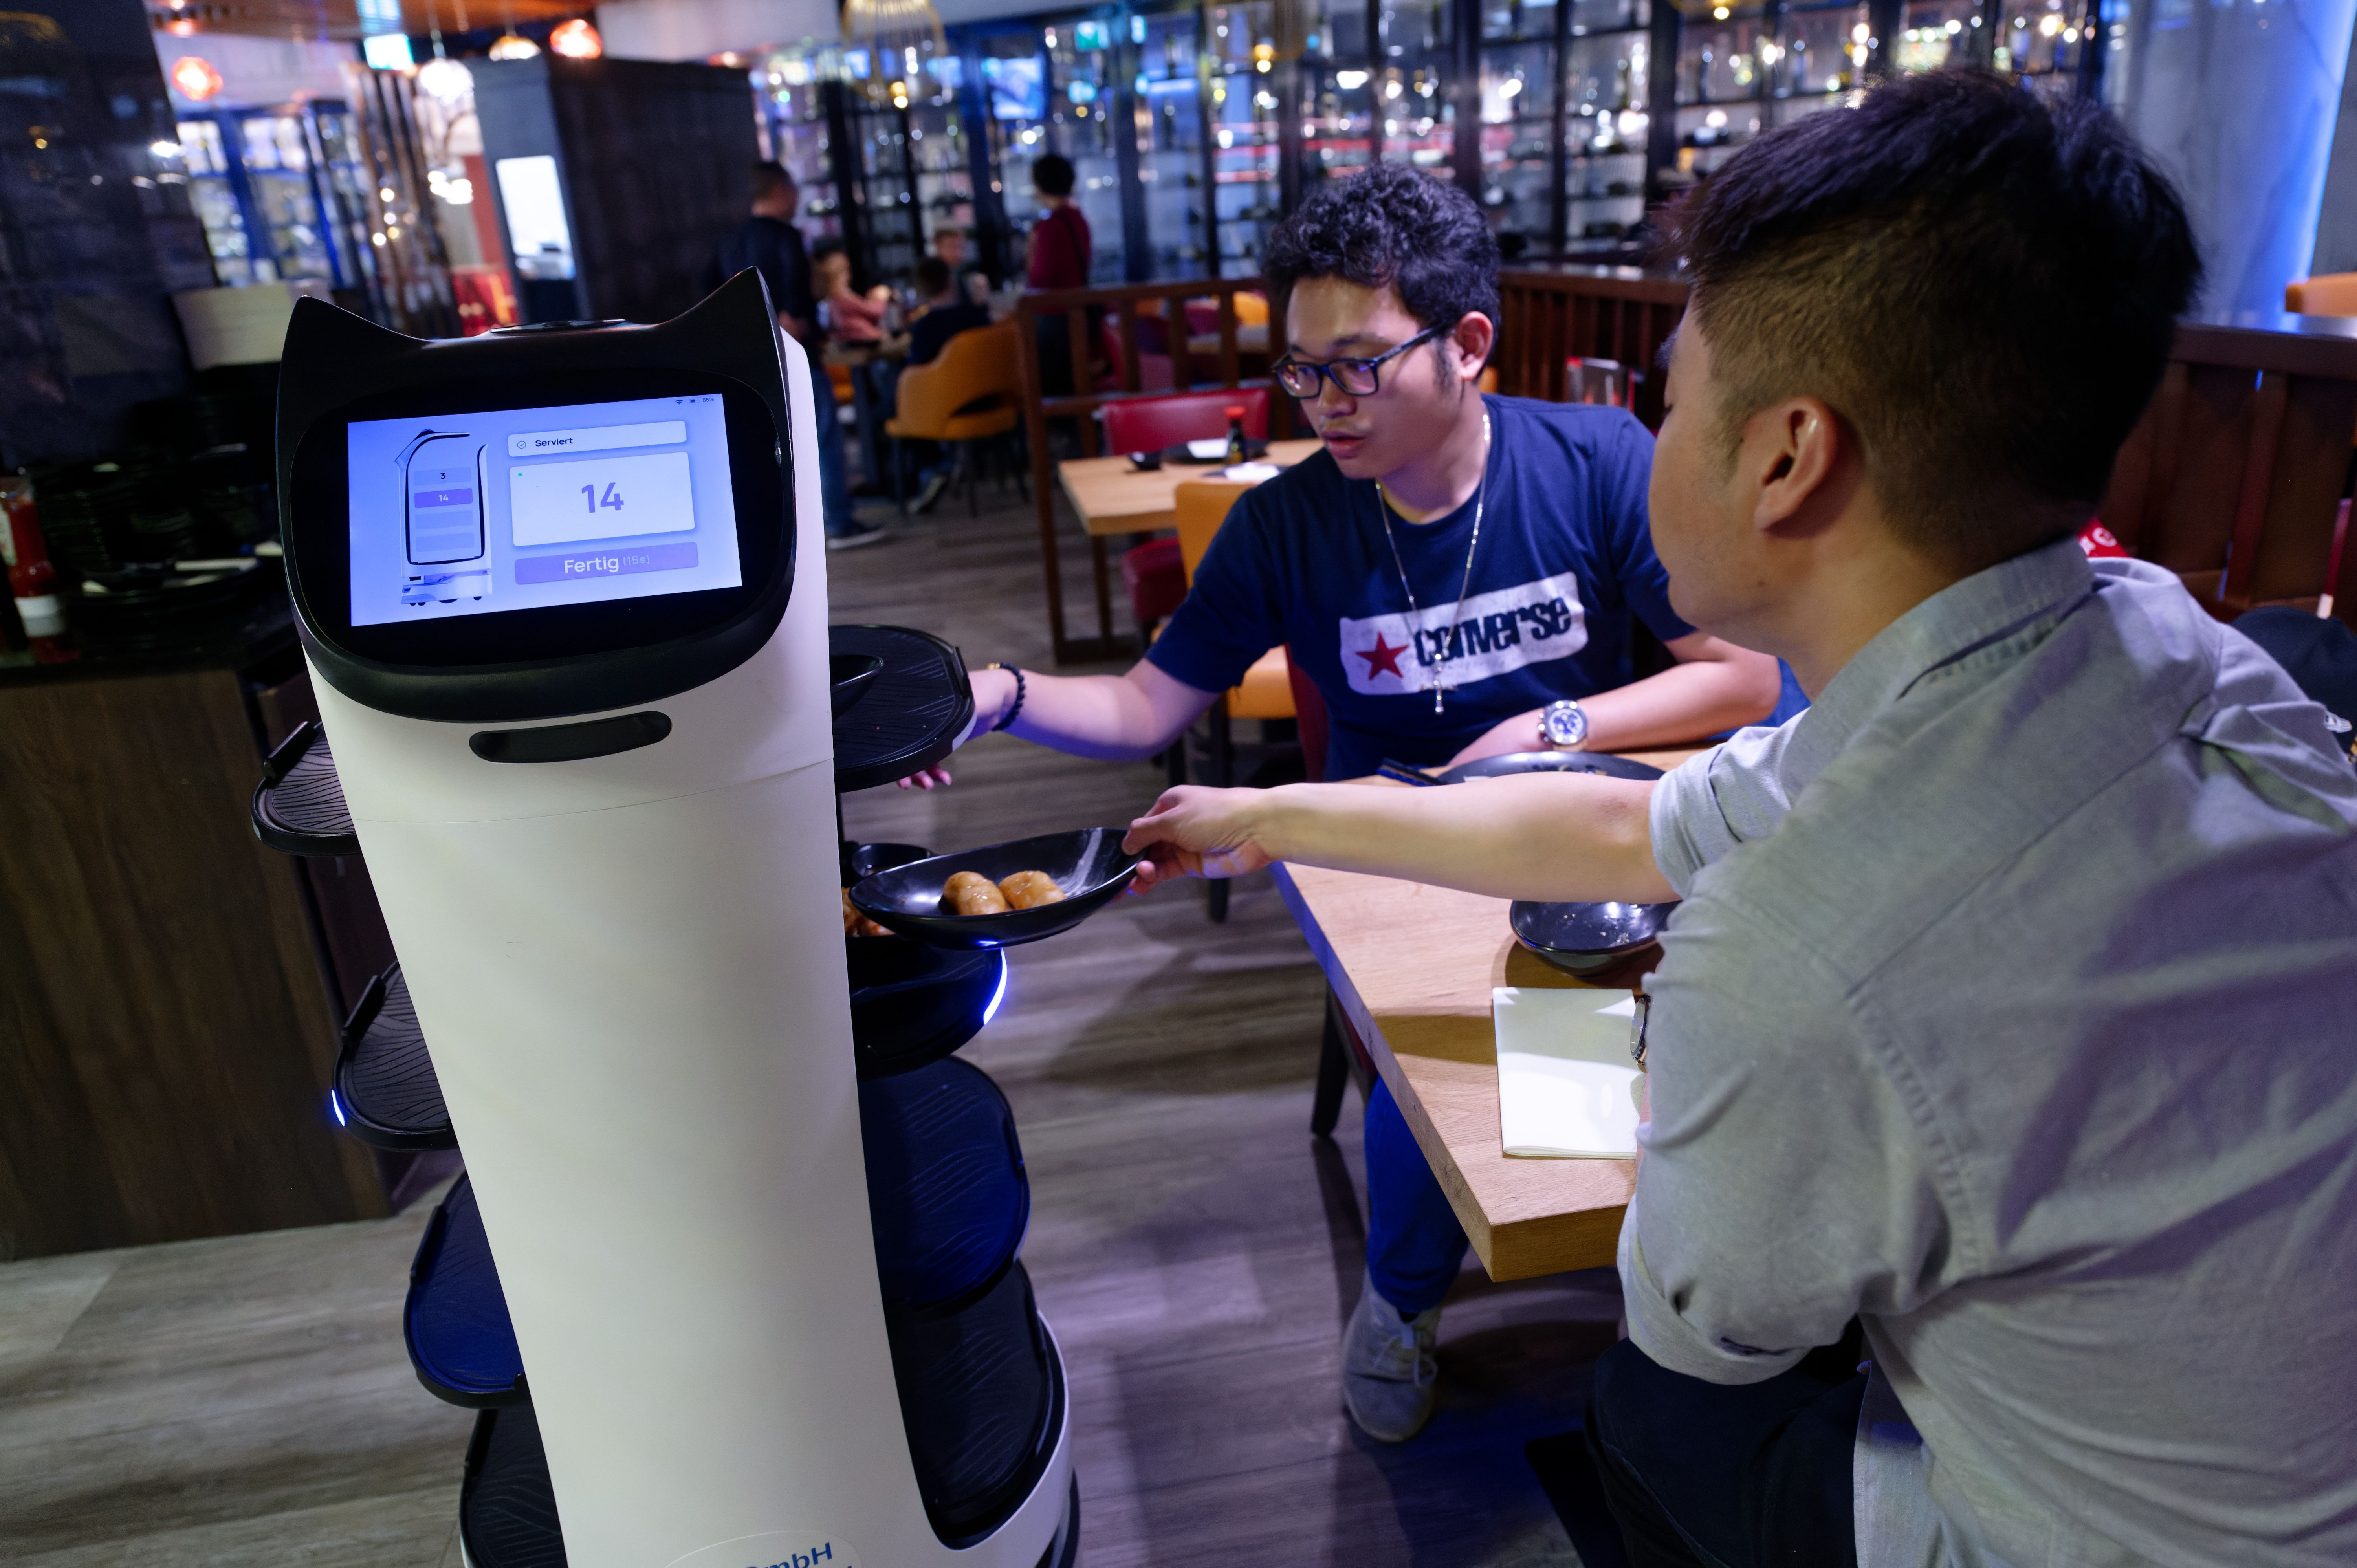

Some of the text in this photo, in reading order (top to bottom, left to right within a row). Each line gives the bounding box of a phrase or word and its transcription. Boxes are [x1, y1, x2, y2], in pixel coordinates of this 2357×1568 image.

[535, 438, 573, 447] Serviert
[582, 482, 624, 513] 14
[564, 555, 650, 573] Fertig (15s)
